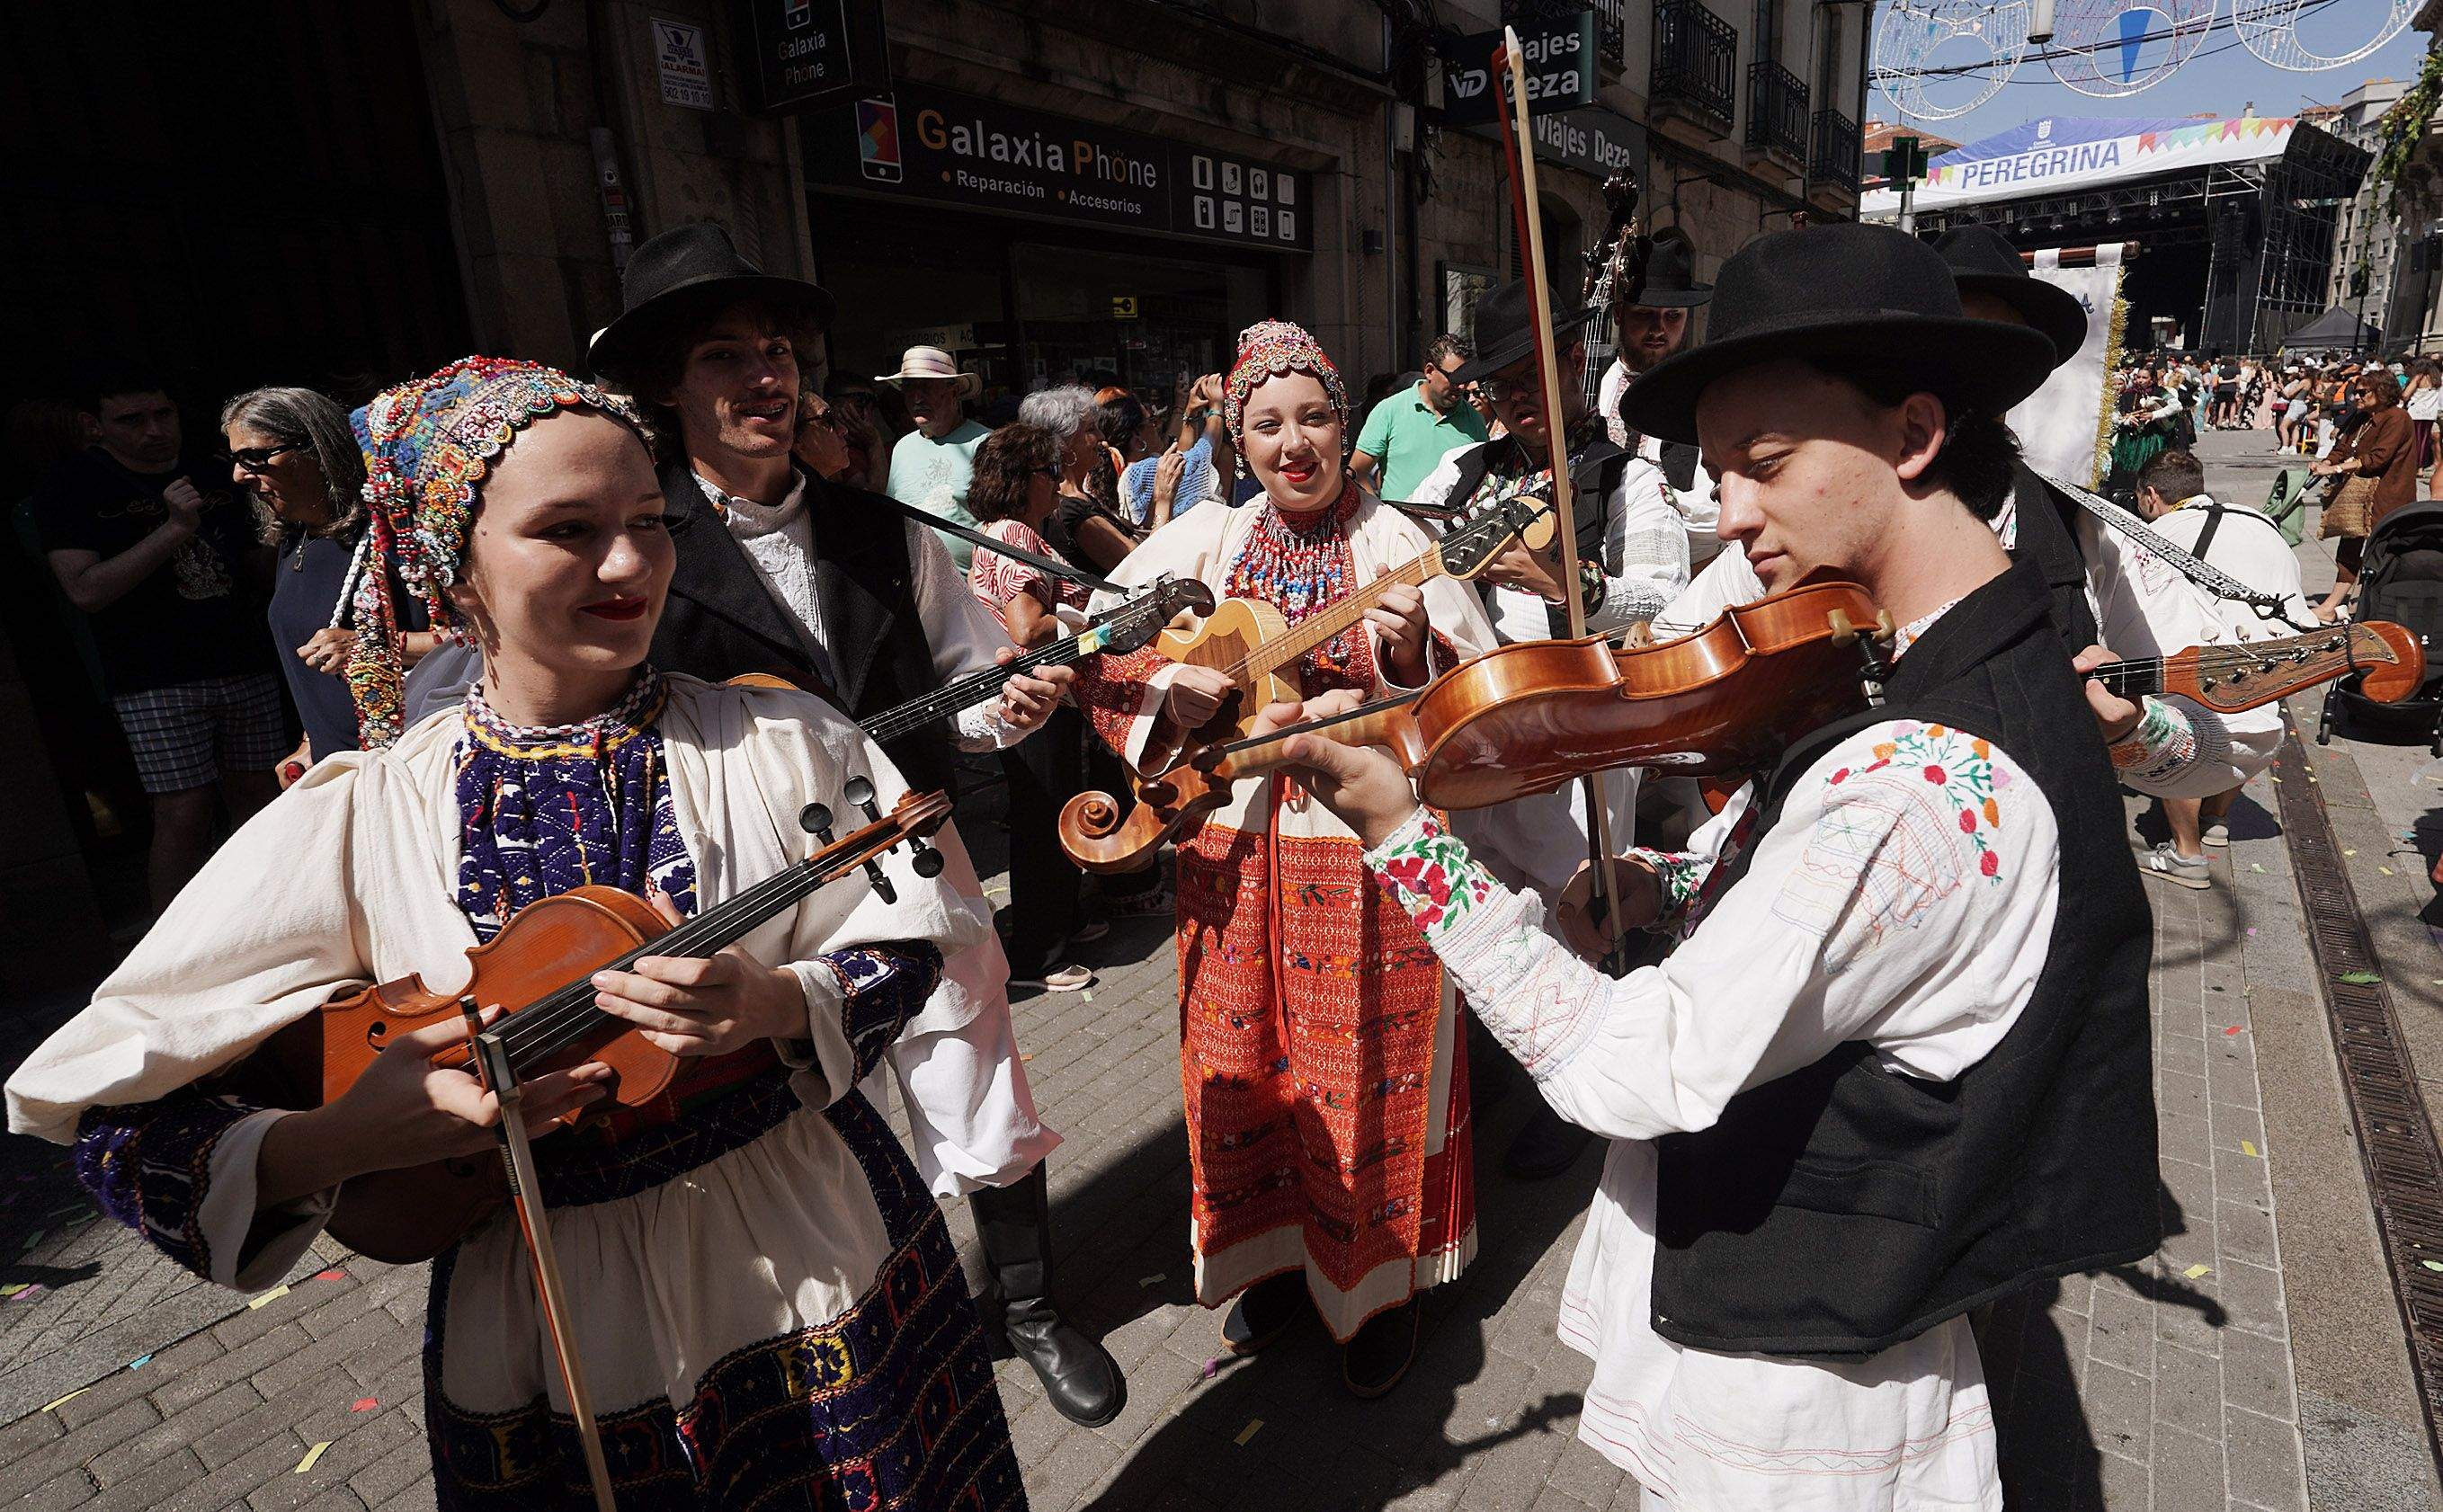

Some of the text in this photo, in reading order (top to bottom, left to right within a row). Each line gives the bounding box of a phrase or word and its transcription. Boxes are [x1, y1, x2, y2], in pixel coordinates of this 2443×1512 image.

[779, 31, 827, 61] Galaxia
[1500, 31, 1580, 64] iajes
[784, 62, 825, 86] Phone
[915, 108, 1157, 189] Galaxia Phone
[1537, 113, 1631, 168] Viajes Deza
[1962, 141, 2120, 189] PEREGRINA
[957, 169, 1142, 216] Reparación Accesorios
